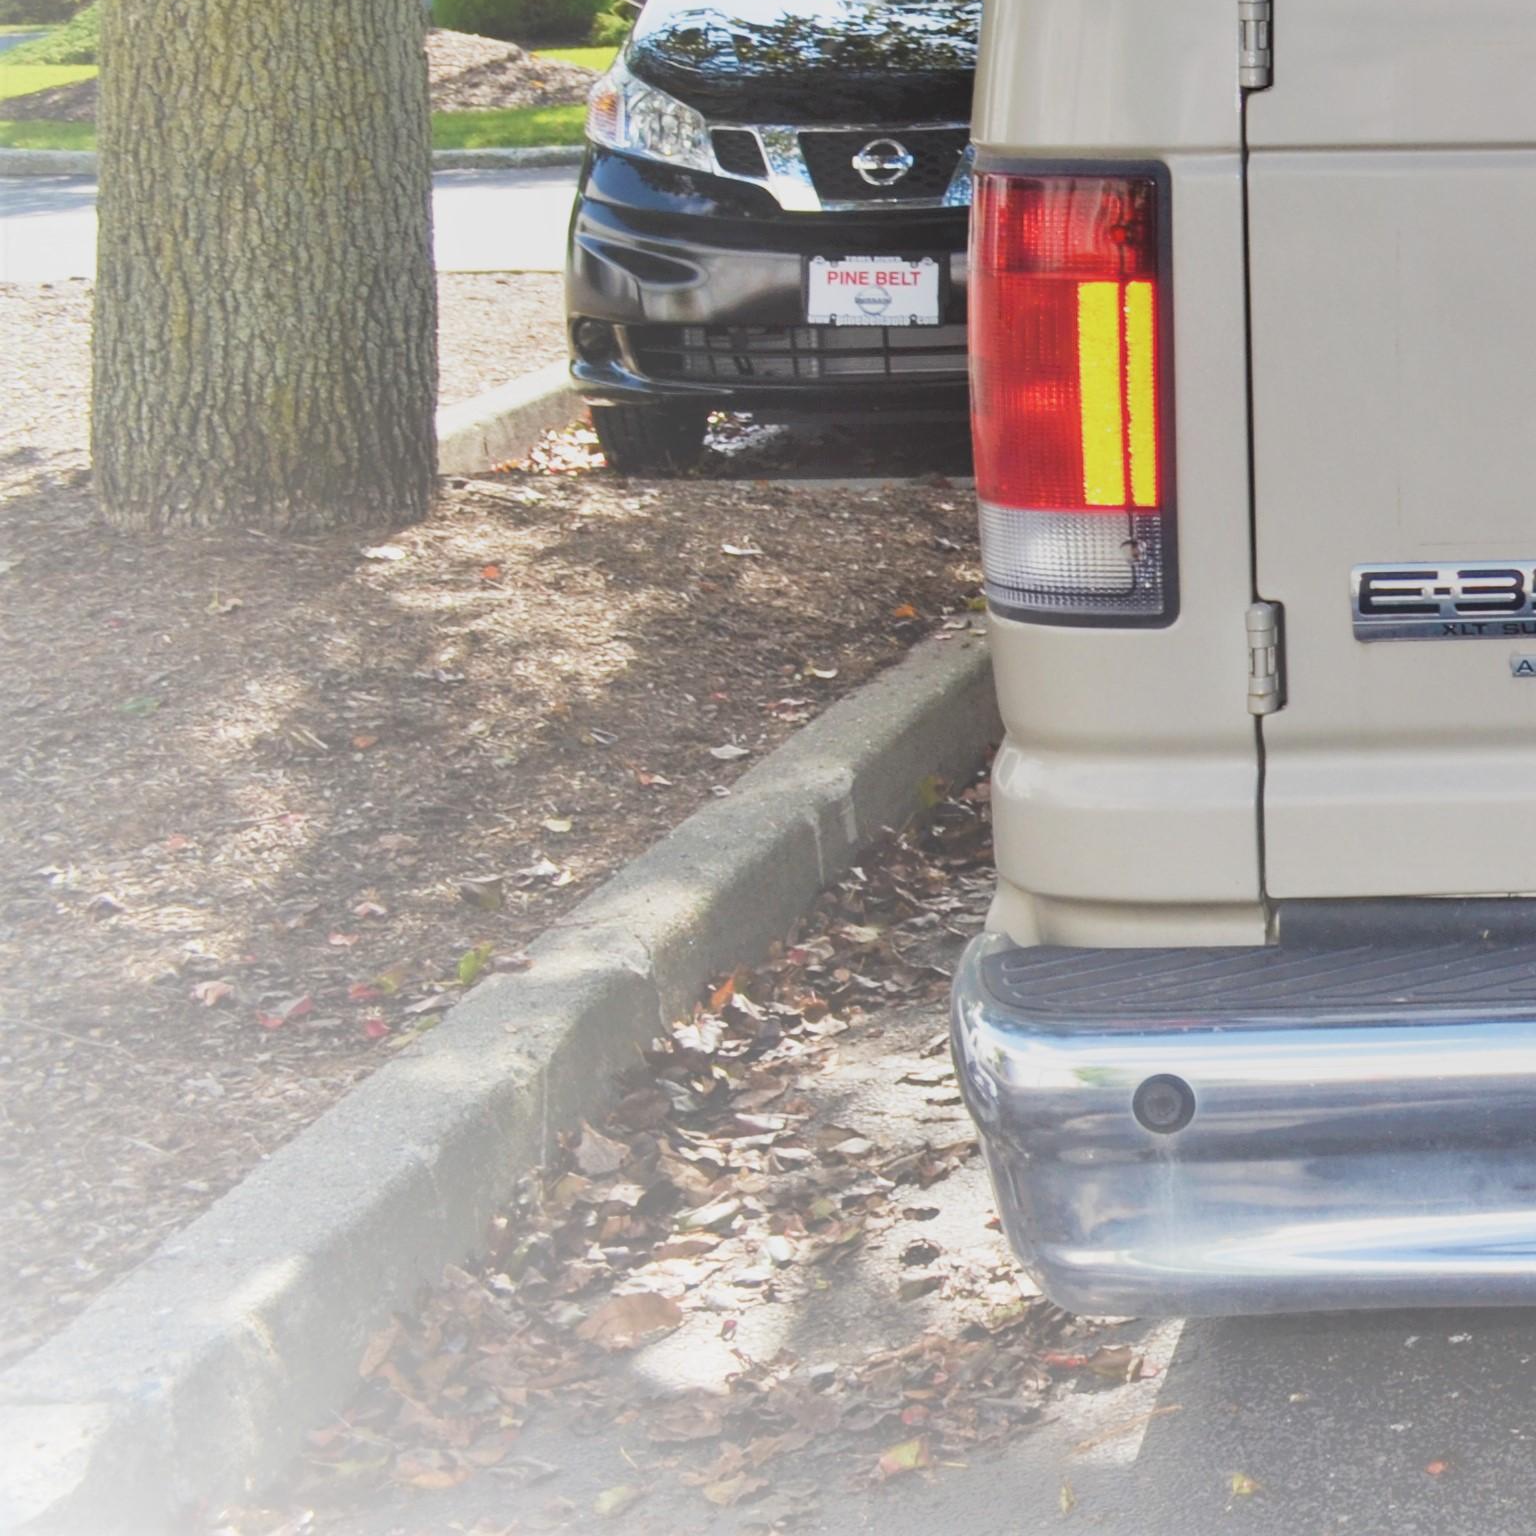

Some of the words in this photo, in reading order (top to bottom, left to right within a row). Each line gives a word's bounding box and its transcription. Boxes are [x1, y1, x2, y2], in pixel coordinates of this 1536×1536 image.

[827, 270, 870, 286] PINE
[875, 270, 922, 286] BELT
[1441, 622, 1488, 637] XLT
